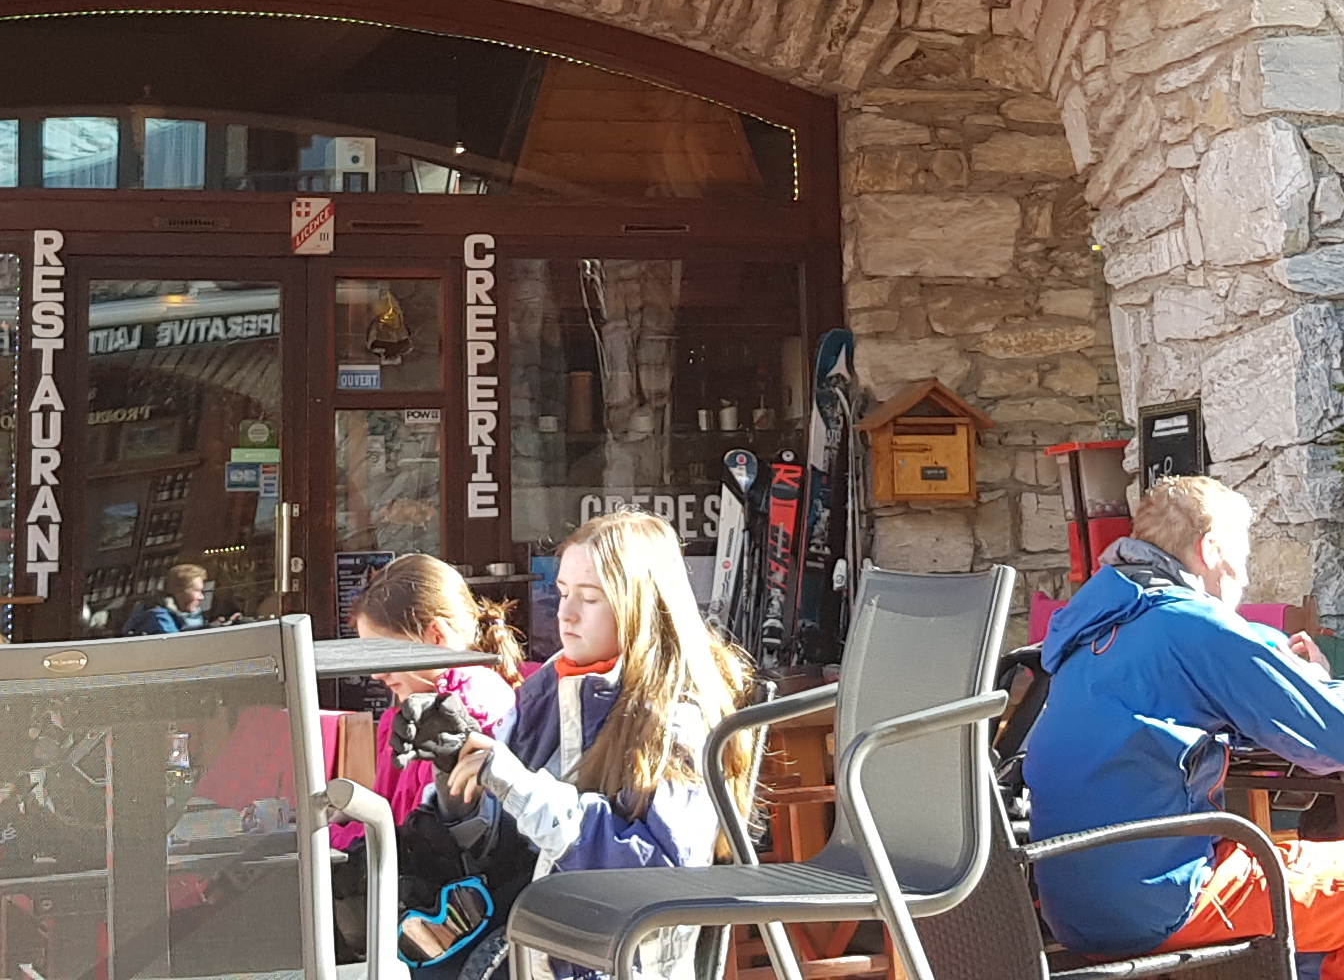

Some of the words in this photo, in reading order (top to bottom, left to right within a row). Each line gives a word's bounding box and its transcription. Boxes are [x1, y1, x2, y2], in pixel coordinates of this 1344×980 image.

[296, 207, 330, 247] LICENCE
[340, 374, 378, 387] OUVERT
[463, 232, 499, 518] CREPERIE
[26, 229, 65, 599] RESTAURANT
[579, 493, 722, 539] CPES
